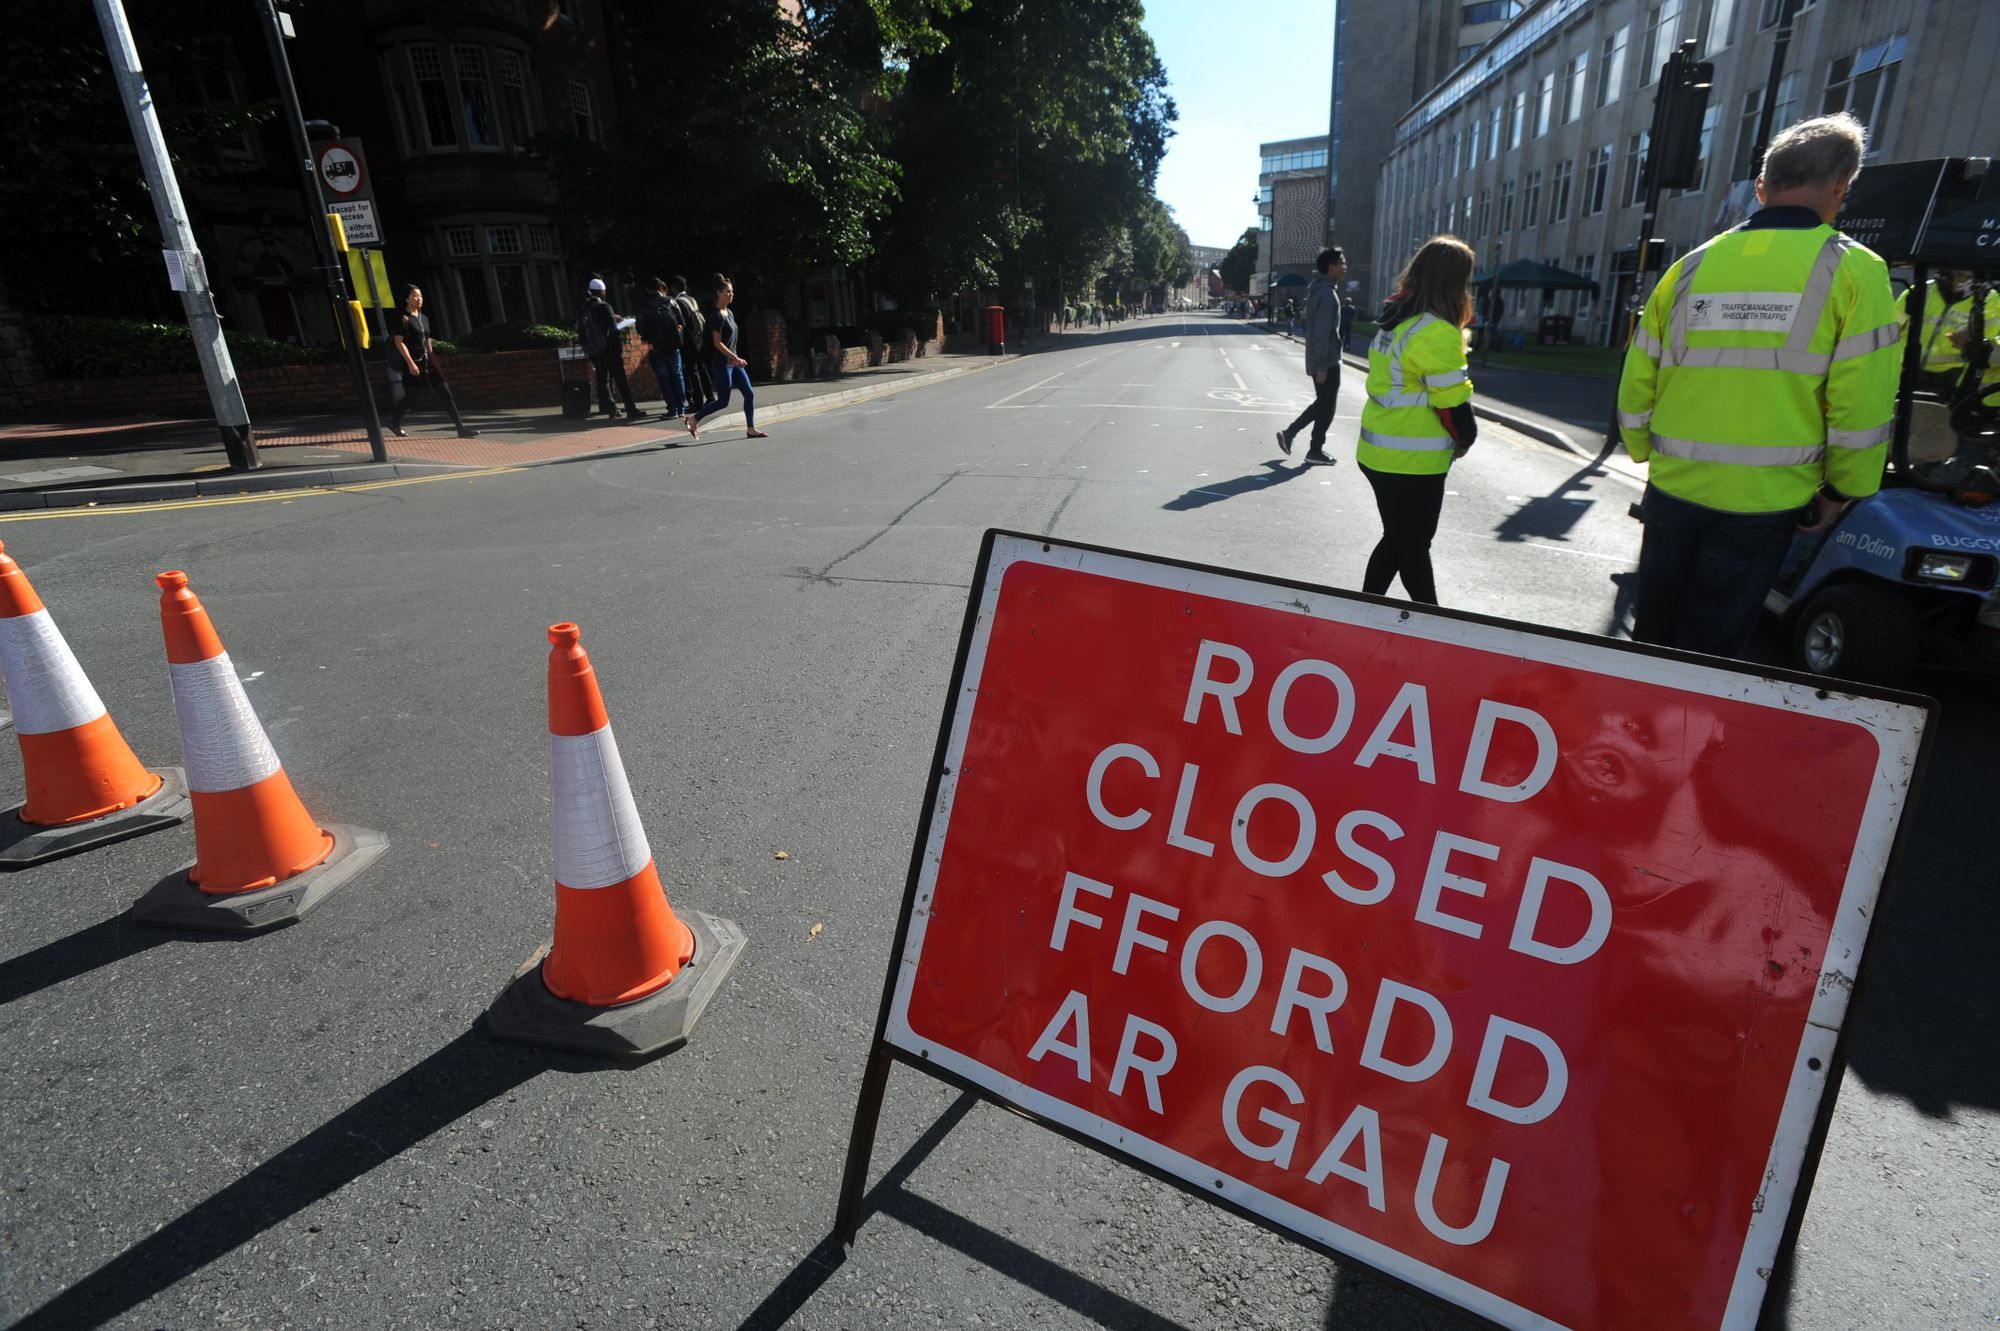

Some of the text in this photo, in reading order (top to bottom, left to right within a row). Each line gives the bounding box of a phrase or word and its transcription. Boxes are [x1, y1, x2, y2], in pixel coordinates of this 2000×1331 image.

[331, 203, 369, 213] Except for
[347, 231, 374, 240] ynediad
[350, 224, 373, 232] eithrio
[1721, 303, 1794, 313] TRAFFIC MANAGEMENT
[1722, 312, 1759, 320] RHEOLAETH
[1857, 534, 1895, 560] Ddim
[1182, 638, 1559, 803] ROAD
[1086, 742, 1613, 965] CLOSED
[1049, 871, 1569, 1125] FFORDD
[1027, 990, 1511, 1246] AR GAU
